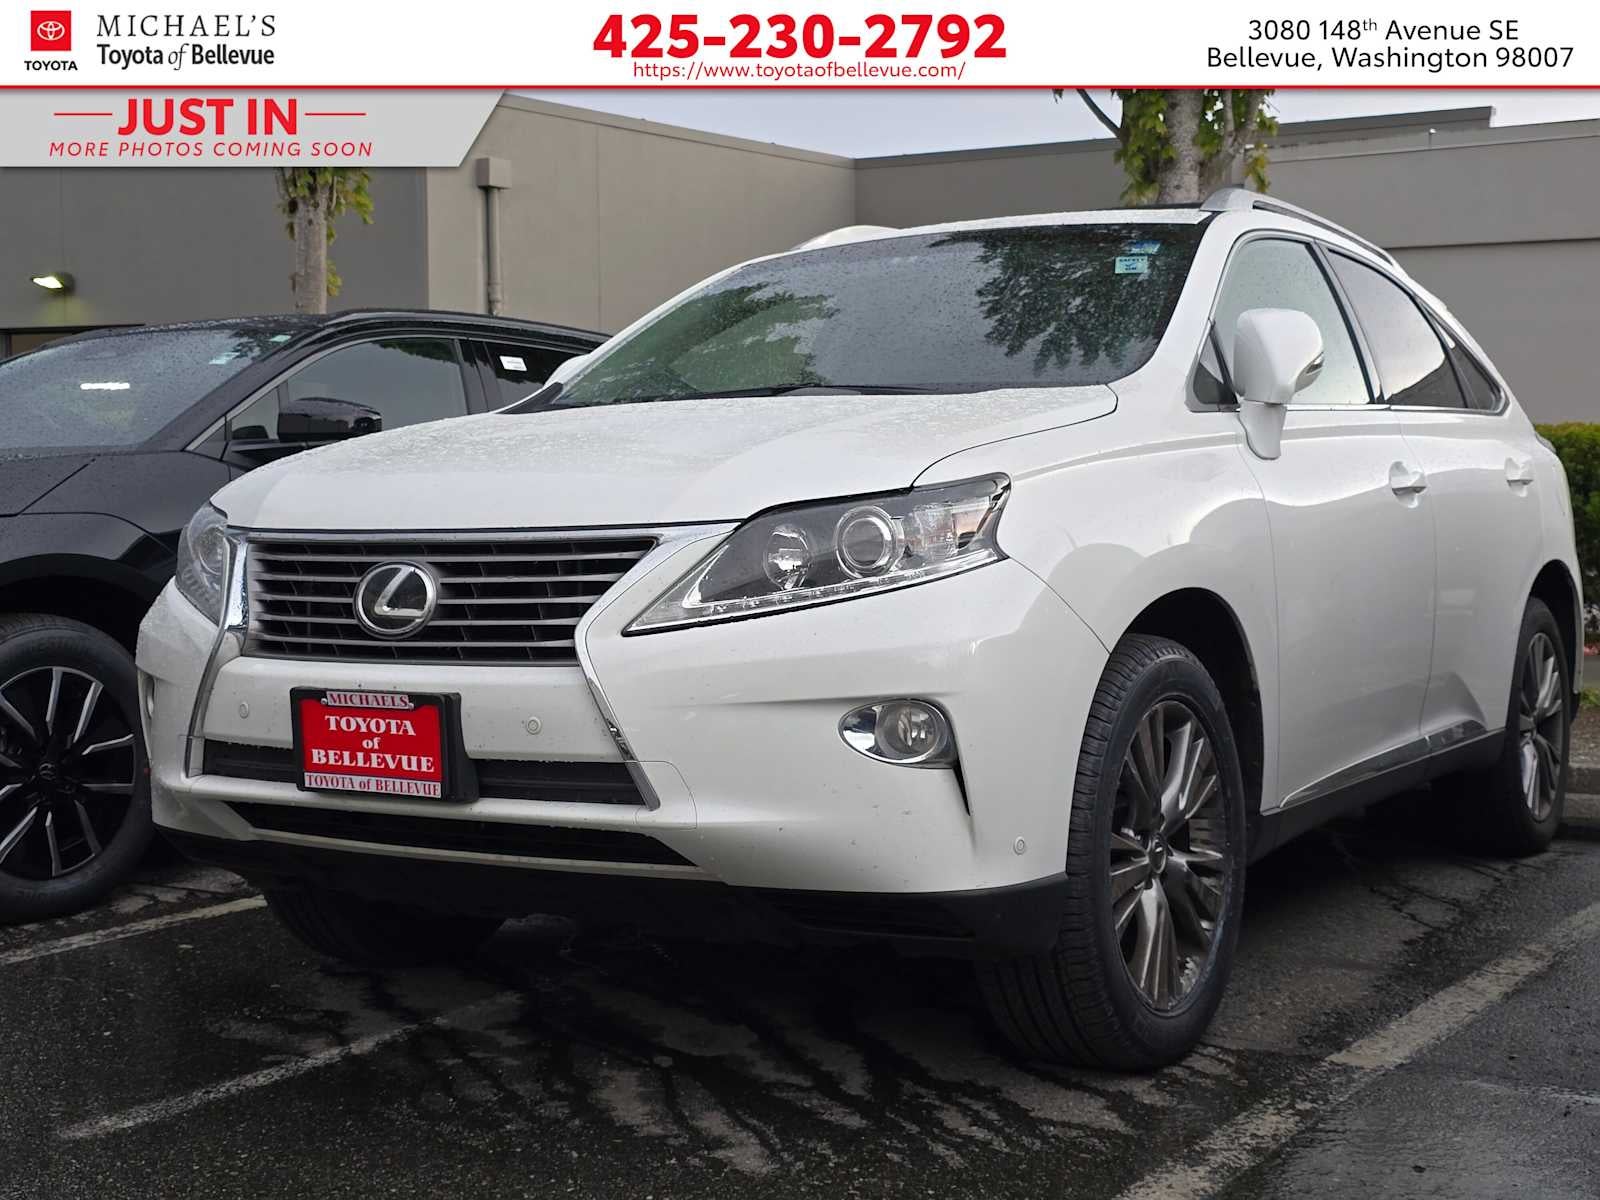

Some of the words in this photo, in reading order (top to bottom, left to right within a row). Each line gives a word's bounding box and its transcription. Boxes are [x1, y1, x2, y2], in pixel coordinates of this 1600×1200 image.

[329, 693, 409, 707] MICHAELS
[324, 715, 416, 736] TOYOTA
[362, 737, 381, 750] of
[311, 749, 435, 772] BELLEVUE
[306, 775, 355, 789] TOYOTA
[359, 777, 371, 791] of
[376, 780, 440, 796] BELLEVUE
